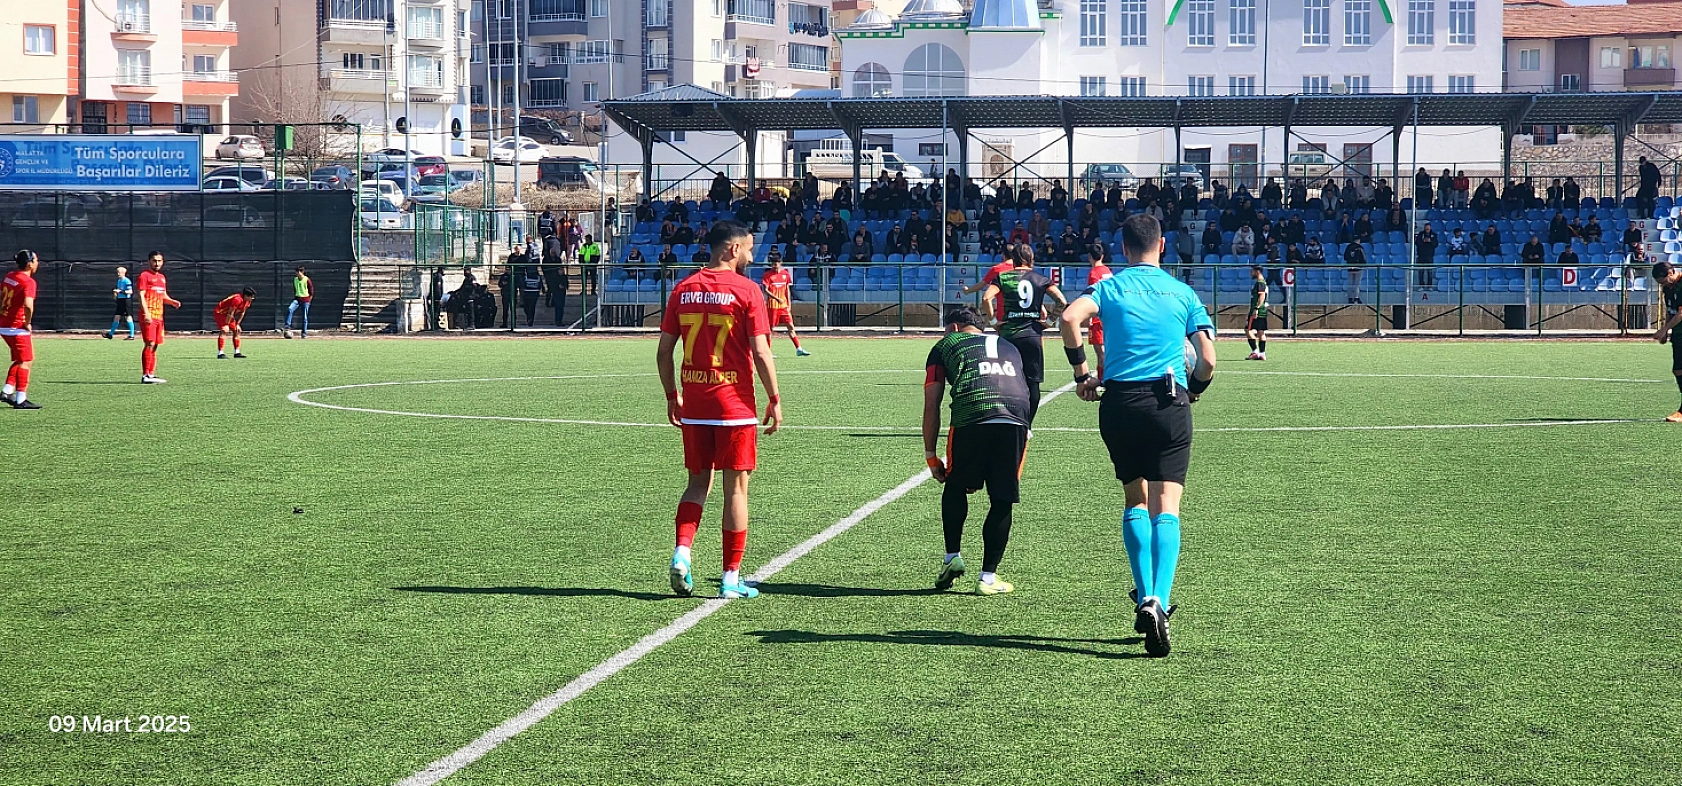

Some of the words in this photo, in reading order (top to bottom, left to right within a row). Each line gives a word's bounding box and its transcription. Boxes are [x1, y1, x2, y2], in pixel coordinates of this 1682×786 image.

[75, 147, 105, 159] Tüm
[109, 147, 185, 162] Sporculara
[76, 165, 141, 180] Başarılar
[145, 165, 190, 178] Dileriz
[1647, 243, 1652, 251] E
[1284, 269, 1294, 285] C
[1564, 269, 1576, 285] D
[704, 292, 736, 306] GROUP
[1017, 280, 1034, 309] 9
[678, 312, 735, 368] 77
[682, 369, 708, 384] HAMZA
